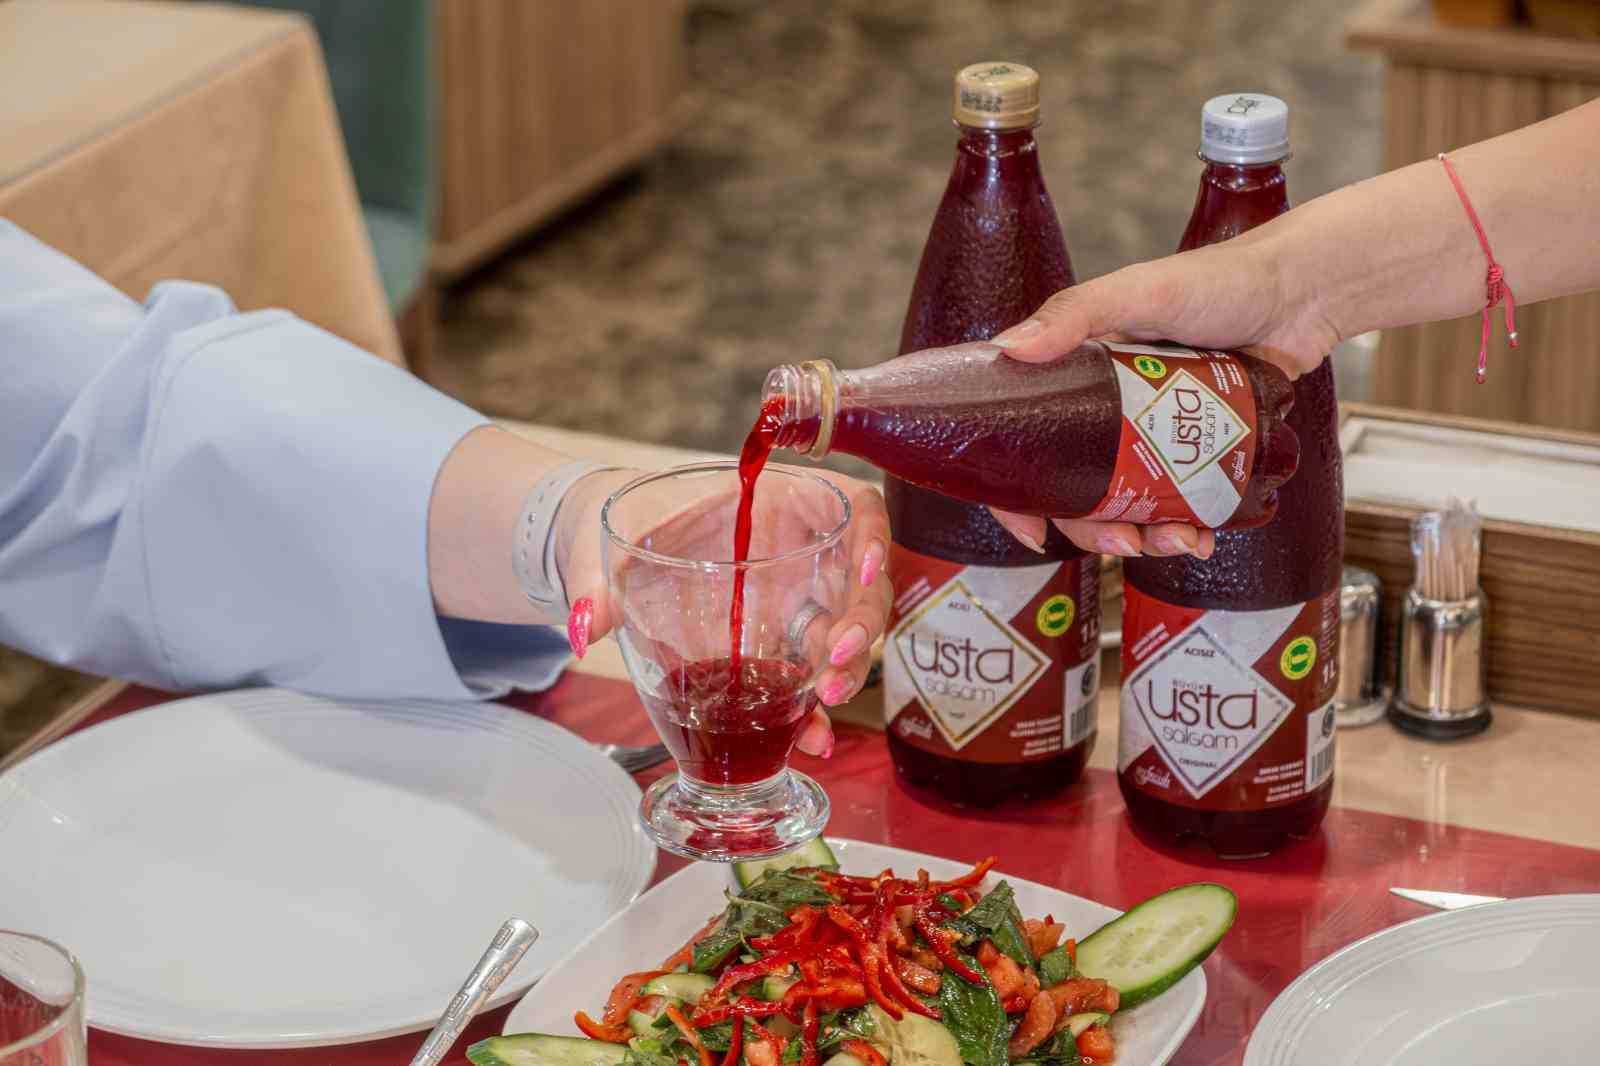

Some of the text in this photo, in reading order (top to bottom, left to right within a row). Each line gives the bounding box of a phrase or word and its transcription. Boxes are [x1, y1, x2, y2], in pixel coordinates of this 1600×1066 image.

[1172, 386, 1203, 465] usta
[910, 631, 1014, 685] usta
[1147, 679, 1258, 730] usta
